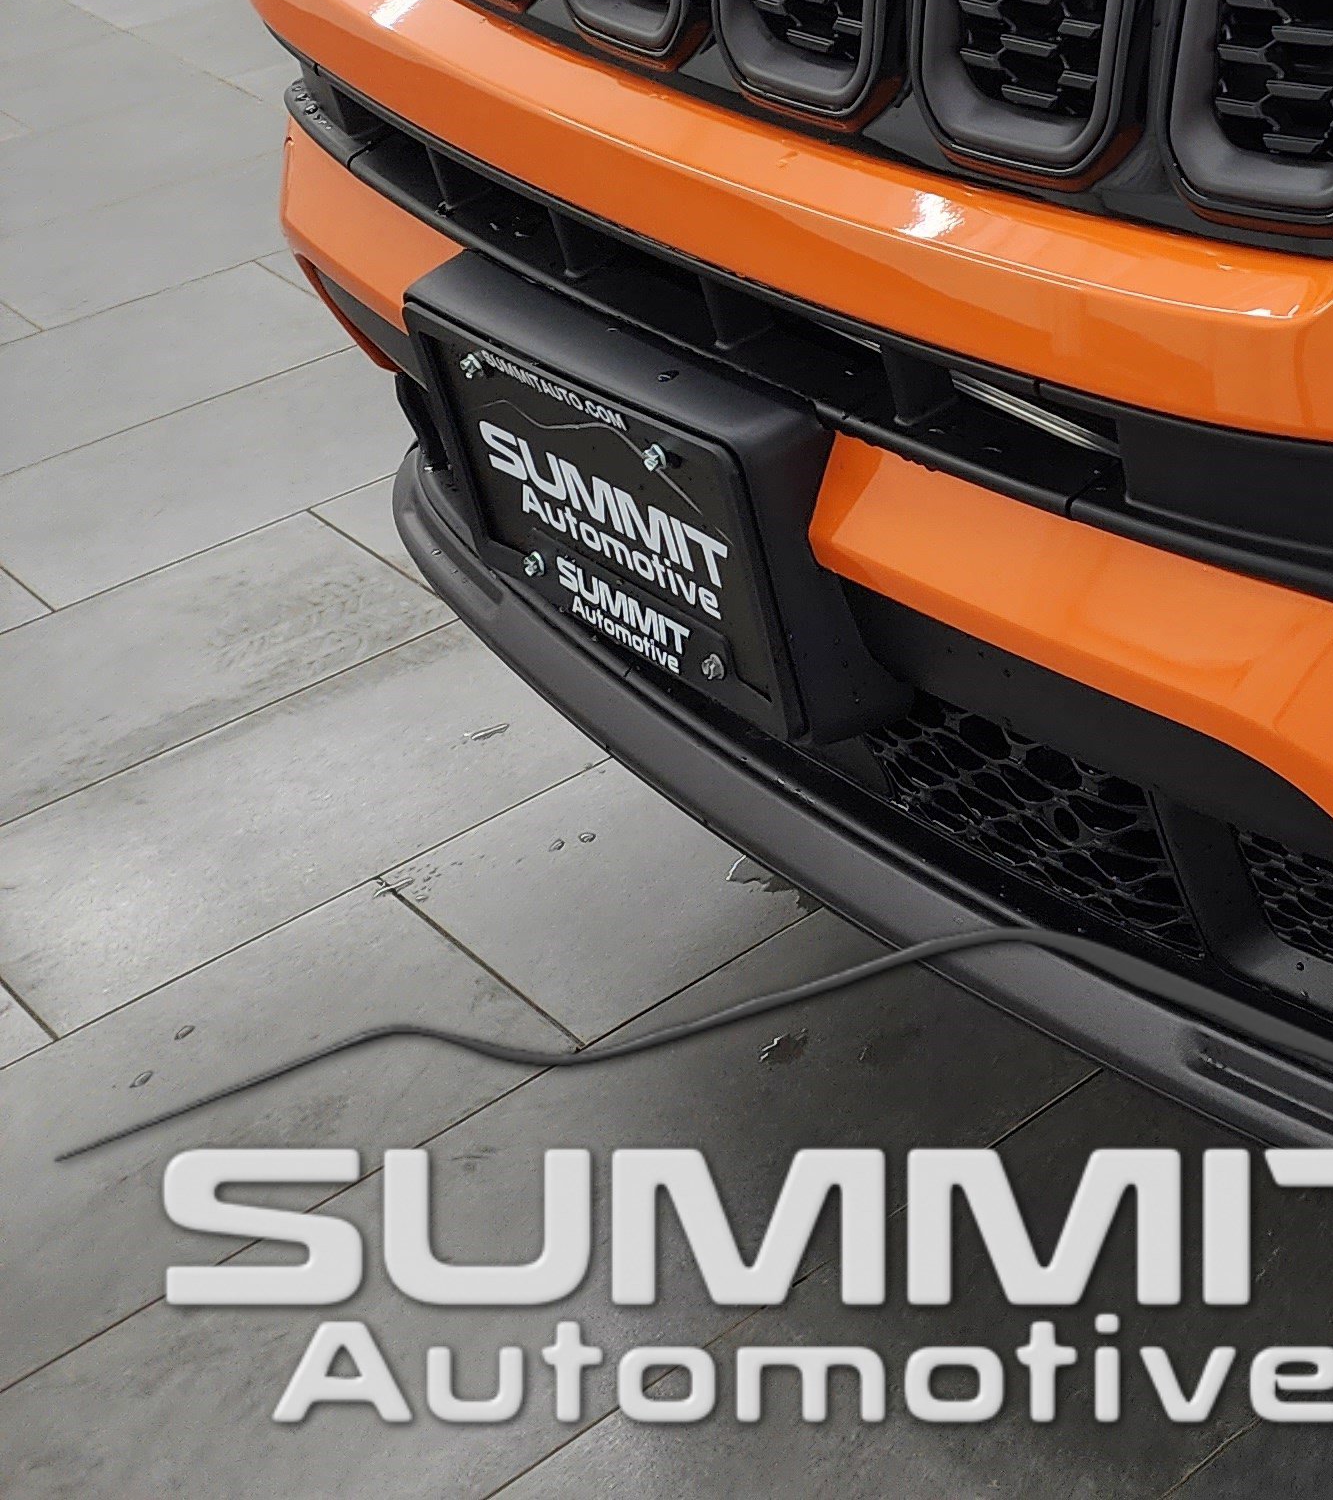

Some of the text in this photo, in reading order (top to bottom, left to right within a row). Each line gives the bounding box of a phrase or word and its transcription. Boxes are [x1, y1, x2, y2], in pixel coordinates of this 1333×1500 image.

[481, 350, 628, 432] SUMMITAUTO.COM
[479, 421, 728, 589] SUMMIT
[522, 484, 721, 621] Automotive
[556, 556, 690, 654] SUMMIT
[572, 595, 680, 674] Automotive
